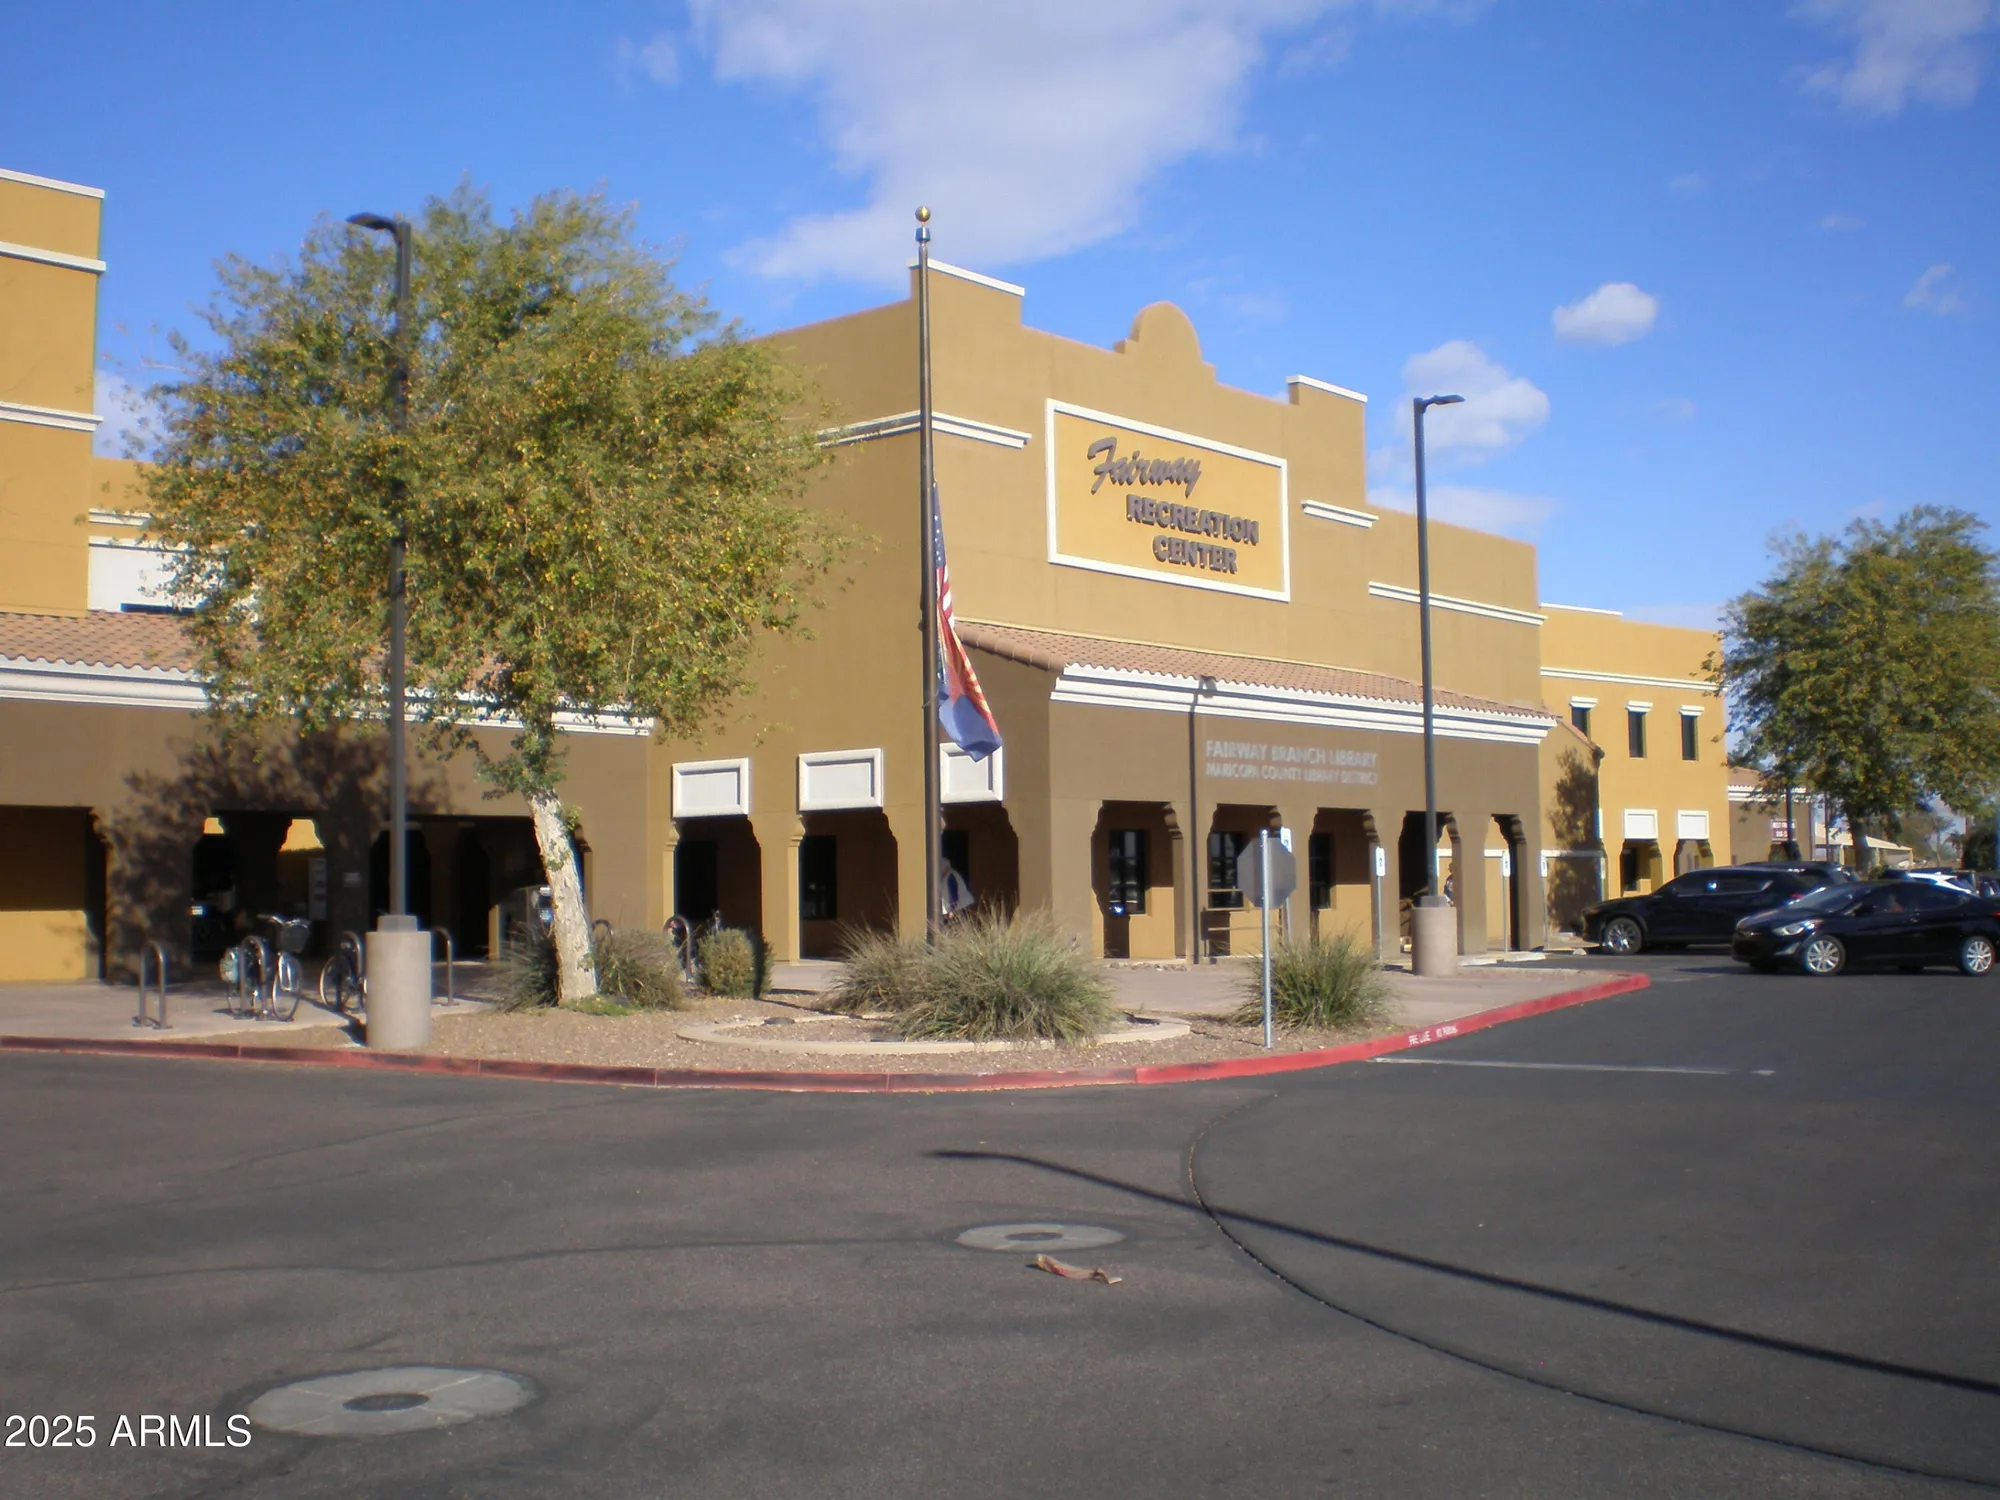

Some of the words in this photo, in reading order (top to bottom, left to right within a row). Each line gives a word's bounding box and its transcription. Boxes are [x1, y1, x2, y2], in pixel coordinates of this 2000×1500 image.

[1087, 436, 1201, 499] Fairway
[1126, 494, 1259, 546] RECREATION
[1153, 535, 1237, 574] CENTER
[1206, 740, 1268, 761] FAIRWAY
[1271, 745, 1326, 764] BRANCH
[1330, 750, 1378, 768] LIBRARY
[1206, 762, 1259, 779] MARICOPA
[1261, 765, 1302, 781] COUNTY
[1304, 769, 1339, 783] LIBRARY
